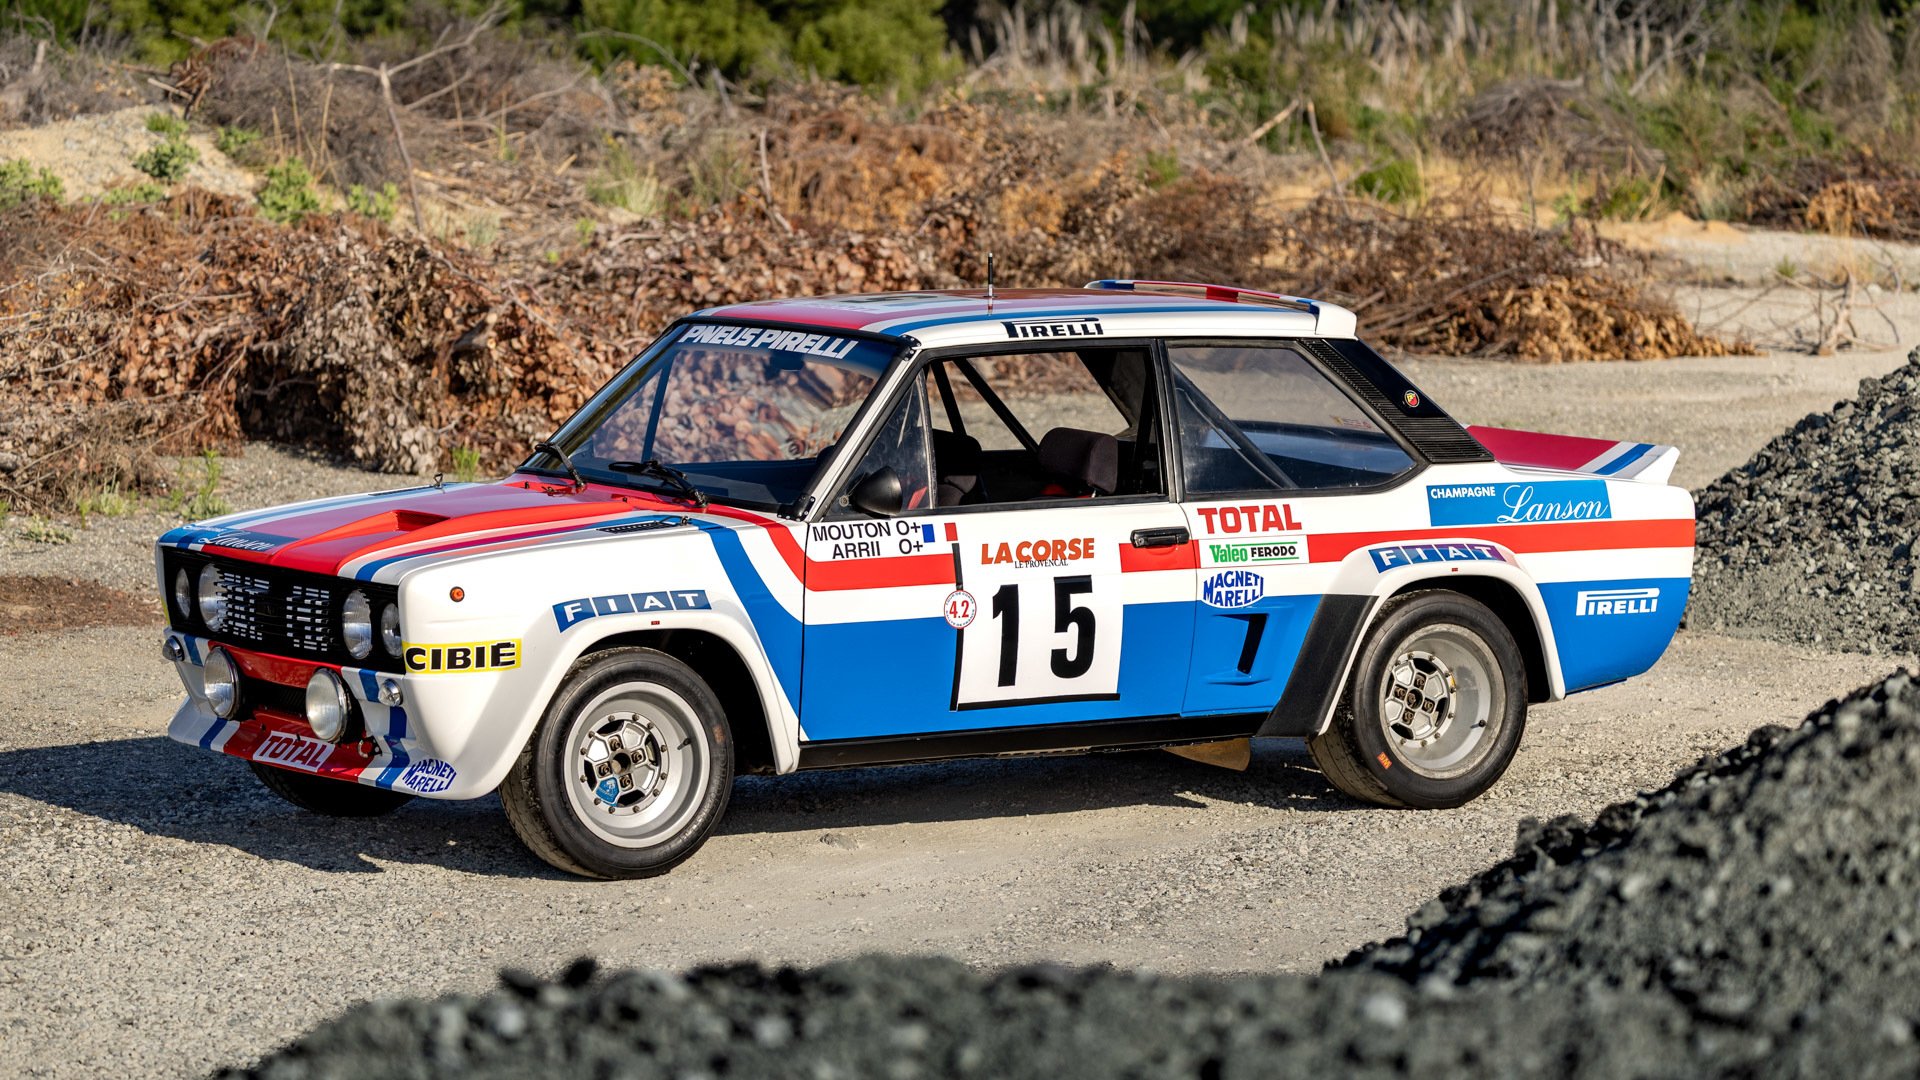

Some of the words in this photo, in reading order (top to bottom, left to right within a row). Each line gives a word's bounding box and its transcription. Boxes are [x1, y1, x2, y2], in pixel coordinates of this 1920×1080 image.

[1001, 317, 1104, 338] PIRELLI
[678, 325, 757, 347] PNEUS
[751, 331, 858, 360] PIRELLI
[1430, 486, 1496, 500] CHAMPAGNE
[1497, 484, 1609, 524] Lanson
[1197, 503, 1302, 534] TOTAL
[812, 521, 891, 542] MOUTON
[832, 541, 881, 560] ARRII
[1209, 544, 1248, 563] Valeo
[1250, 545, 1296, 558] FERODO
[1378, 546, 1495, 567] FIAT
[563, 593, 699, 623] FIAT
[949, 600, 970, 619] 4.2
[1576, 588, 1660, 616] PIRELLI
[259, 735, 330, 768] TOTAL
